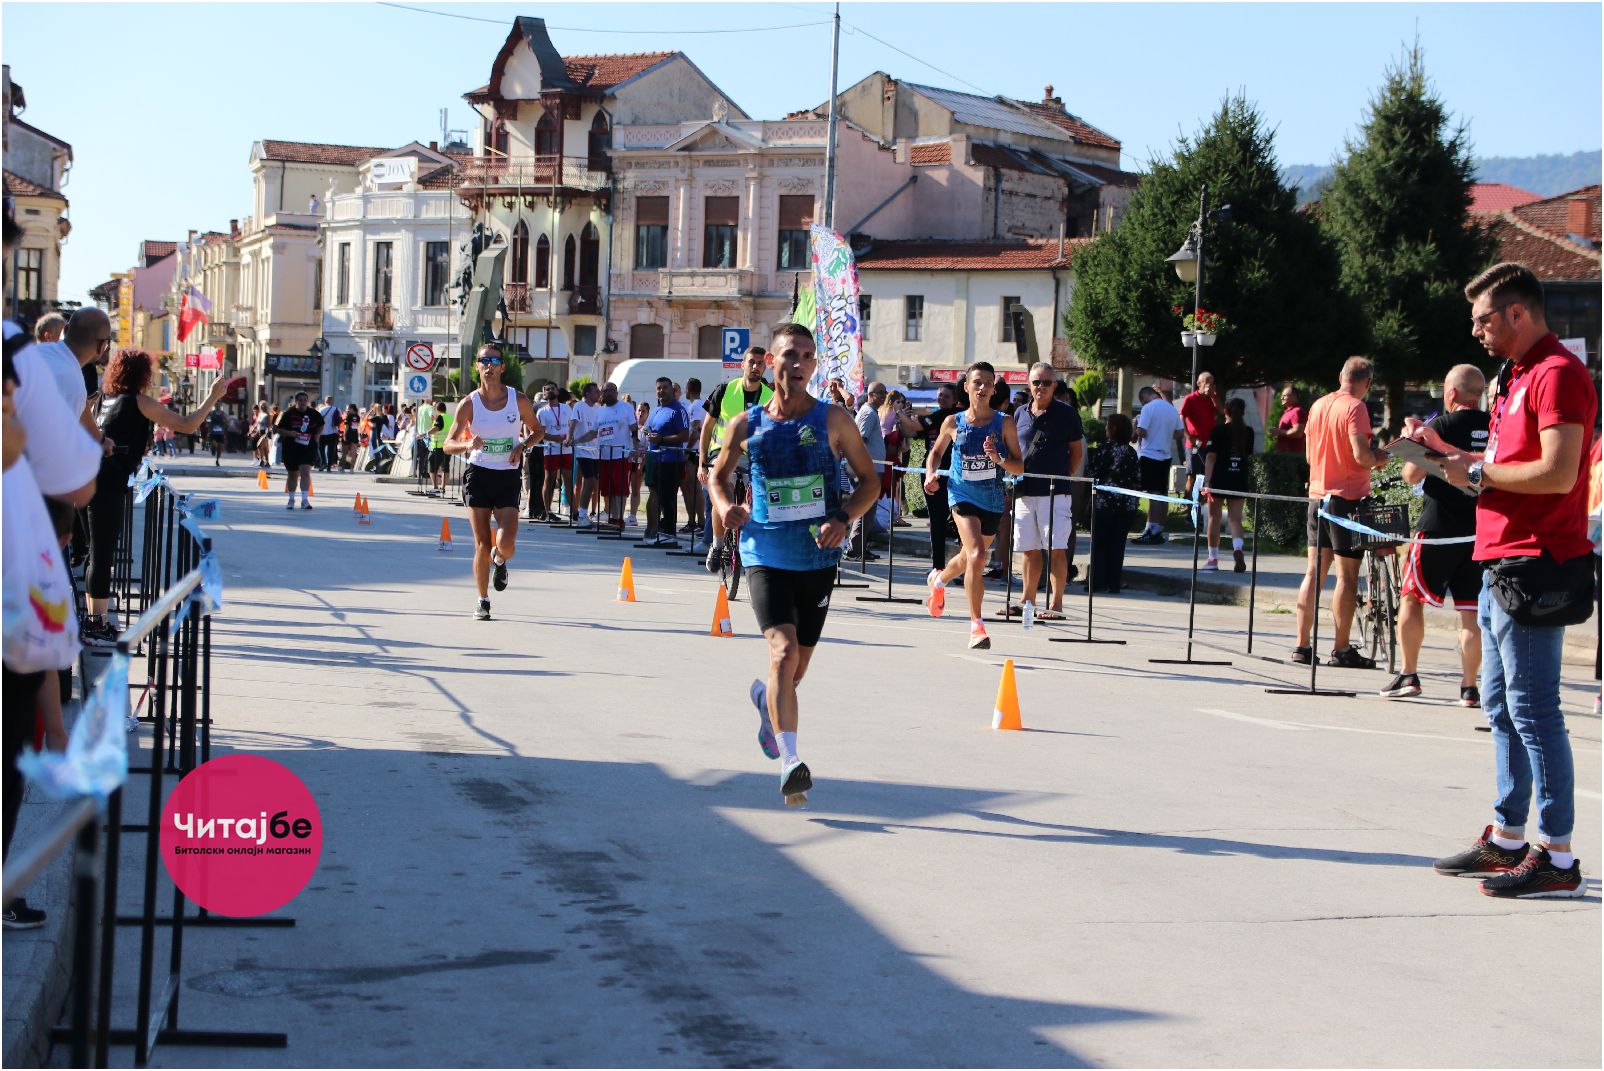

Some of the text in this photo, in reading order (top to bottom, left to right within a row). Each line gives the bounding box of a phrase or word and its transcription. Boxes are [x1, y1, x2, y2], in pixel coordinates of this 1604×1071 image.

[725, 331, 740, 355] P
[491, 445, 504, 453] 107
[970, 461, 986, 470] 639
[791, 489, 801, 502] 8
